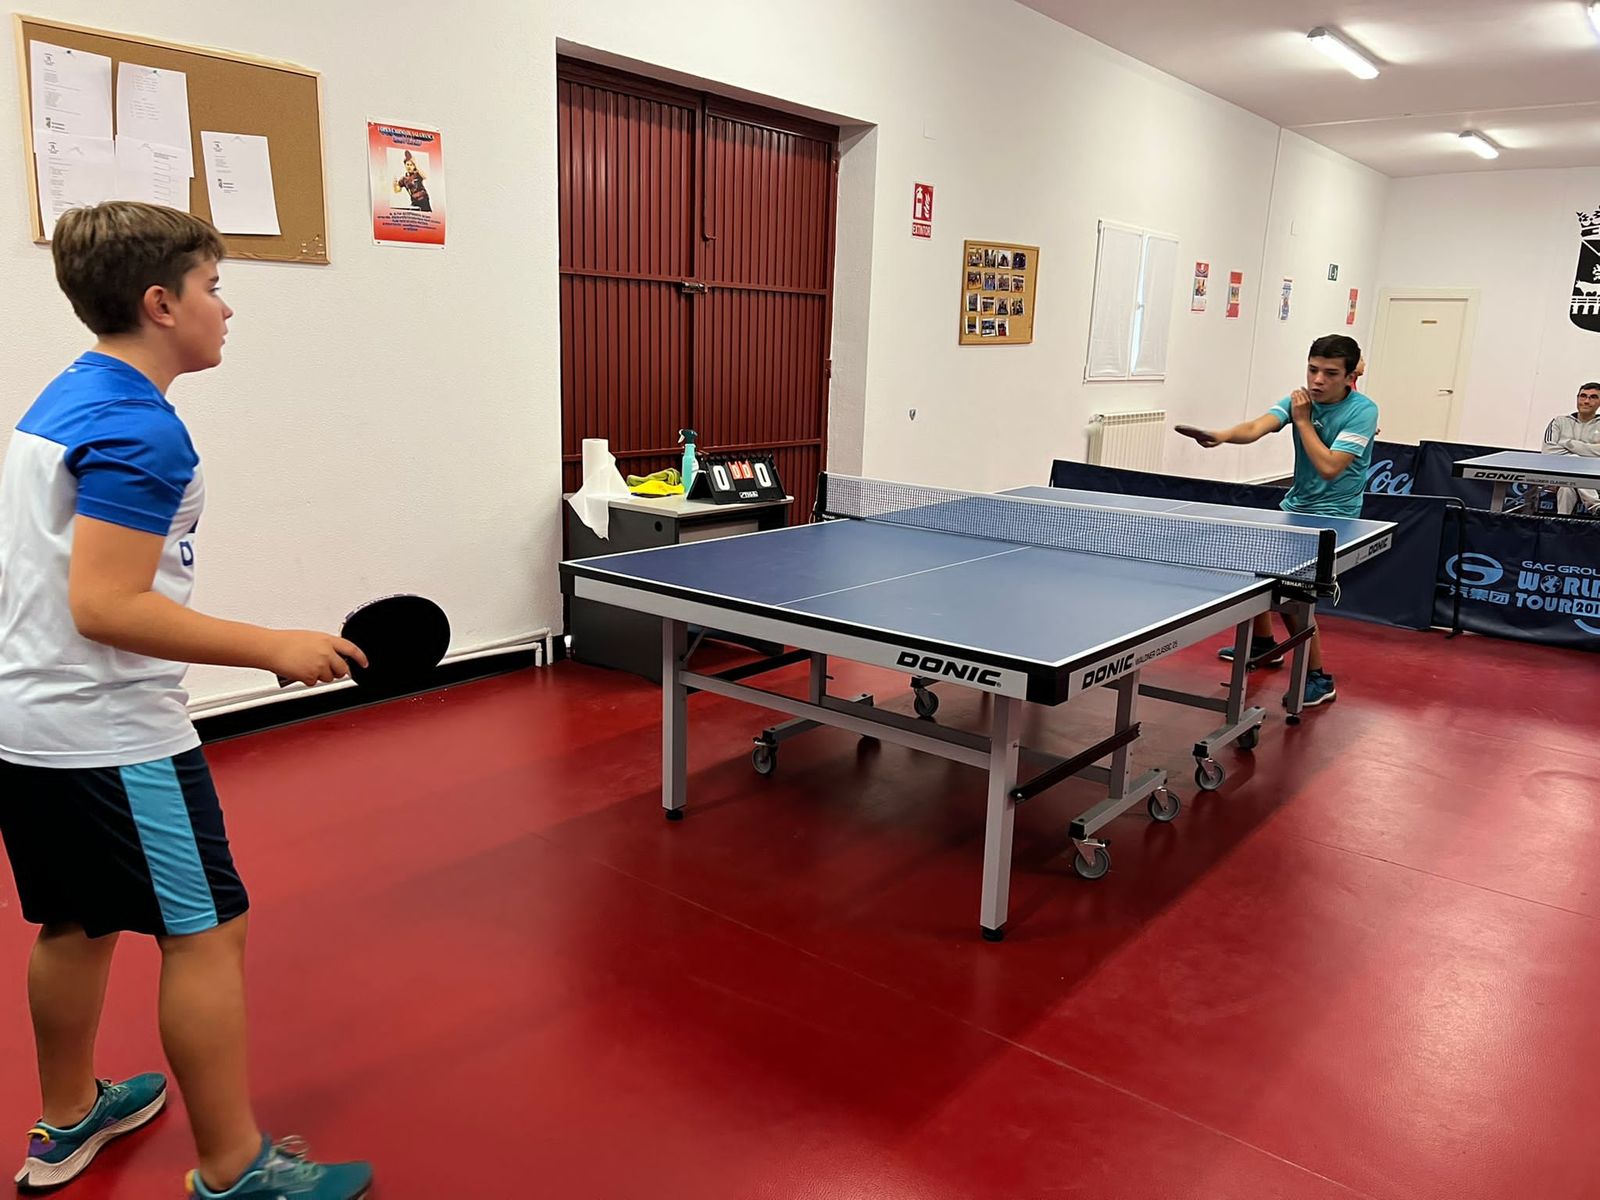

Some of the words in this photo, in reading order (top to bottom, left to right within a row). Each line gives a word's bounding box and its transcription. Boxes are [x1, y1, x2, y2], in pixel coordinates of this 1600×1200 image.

[712, 465, 731, 491] 0
[754, 462, 772, 488] 0
[1474, 471, 1526, 481] DONIC
[1521, 560, 1556, 572] GAC
[896, 651, 1001, 687] DONIC
[1081, 652, 1135, 691] DONIC
